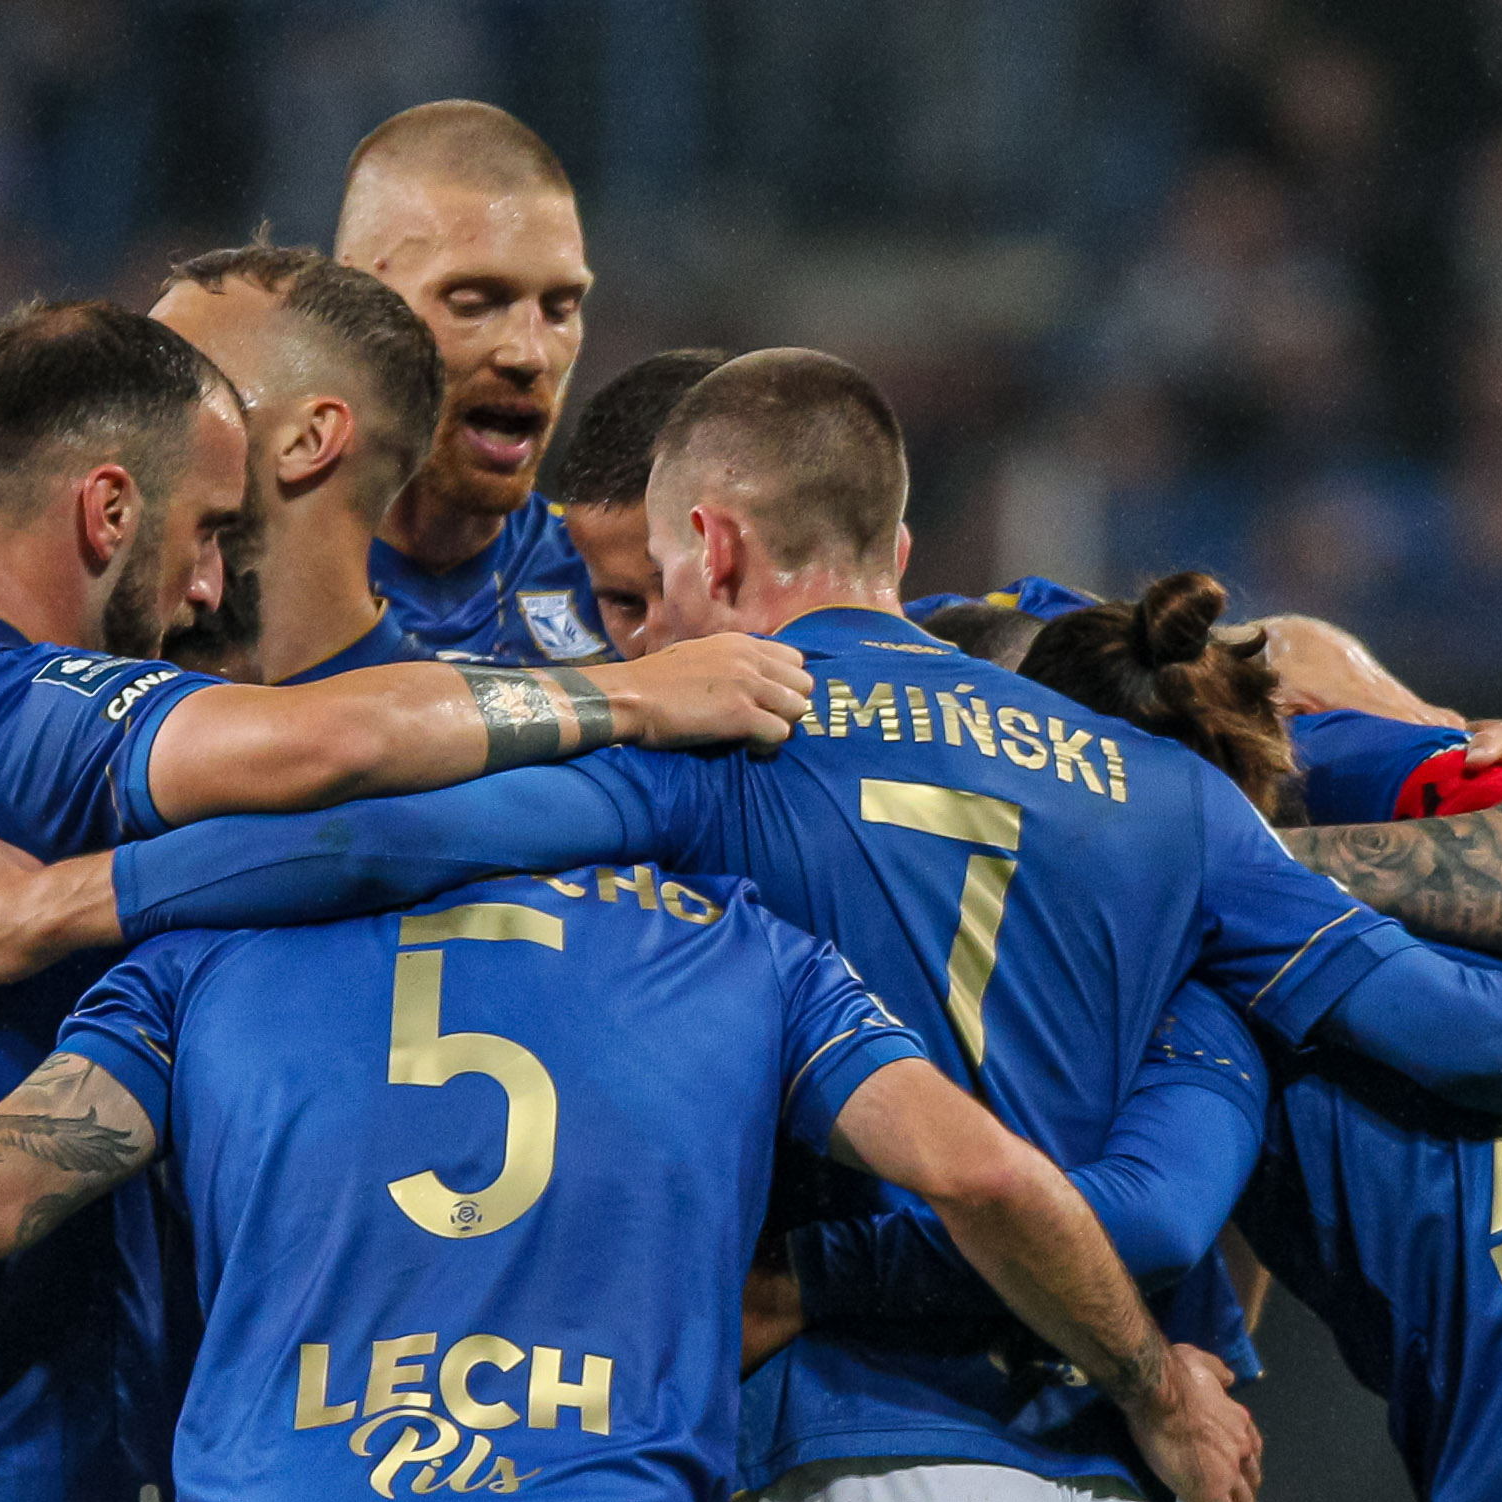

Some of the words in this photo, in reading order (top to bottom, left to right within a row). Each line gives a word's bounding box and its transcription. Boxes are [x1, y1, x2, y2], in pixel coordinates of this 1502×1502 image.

[800, 679, 1128, 803] AMIŃSKI
[861, 778, 1022, 1068] 7
[388, 902, 563, 1239] 5
[294, 1332, 614, 1436] LECH
[348, 1408, 543, 1500] Pils
